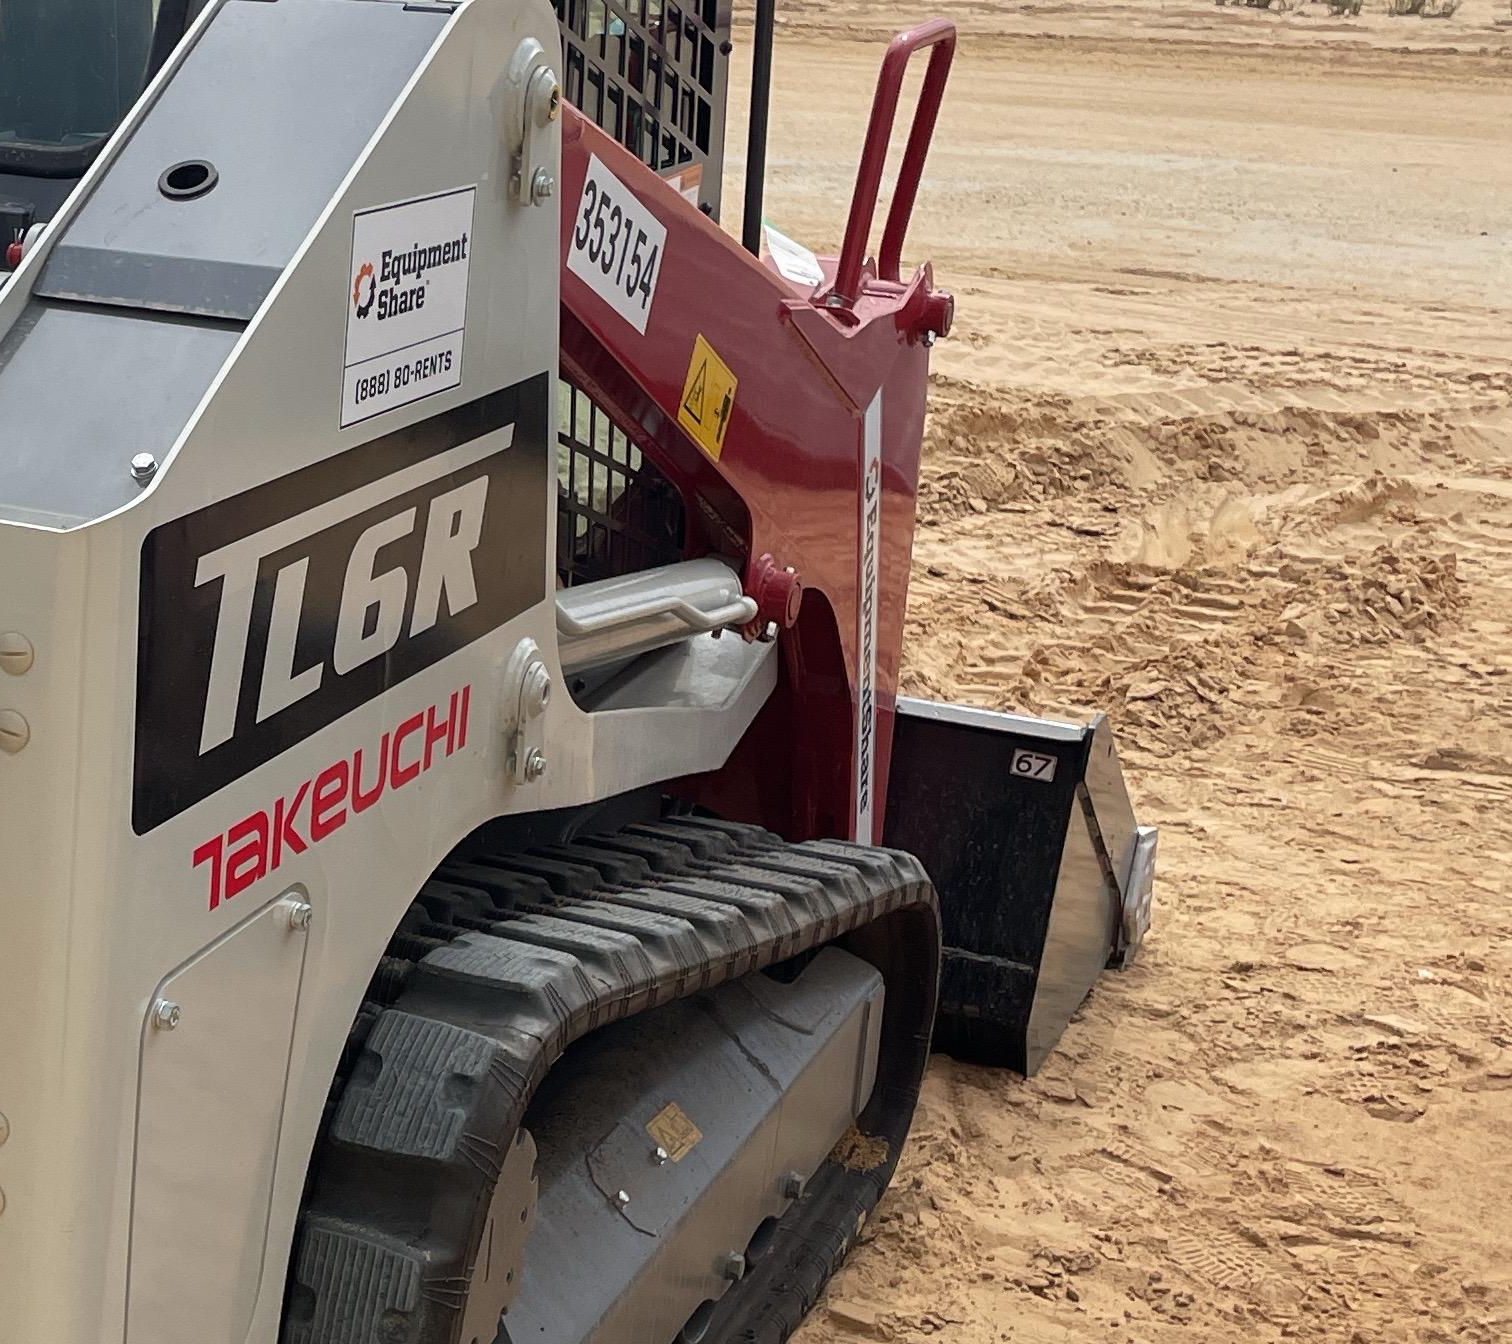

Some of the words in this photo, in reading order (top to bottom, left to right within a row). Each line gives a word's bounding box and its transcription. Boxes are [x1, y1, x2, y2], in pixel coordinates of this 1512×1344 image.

[379, 232, 468, 286] Equipment
[575, 178, 660, 311] 353154
[377, 285, 426, 321] Share
[354, 369, 390, 405] (888)
[393, 349, 453, 389] 80-RENTS
[194, 422, 516, 757] TL6R
[1015, 753, 1053, 776] 67
